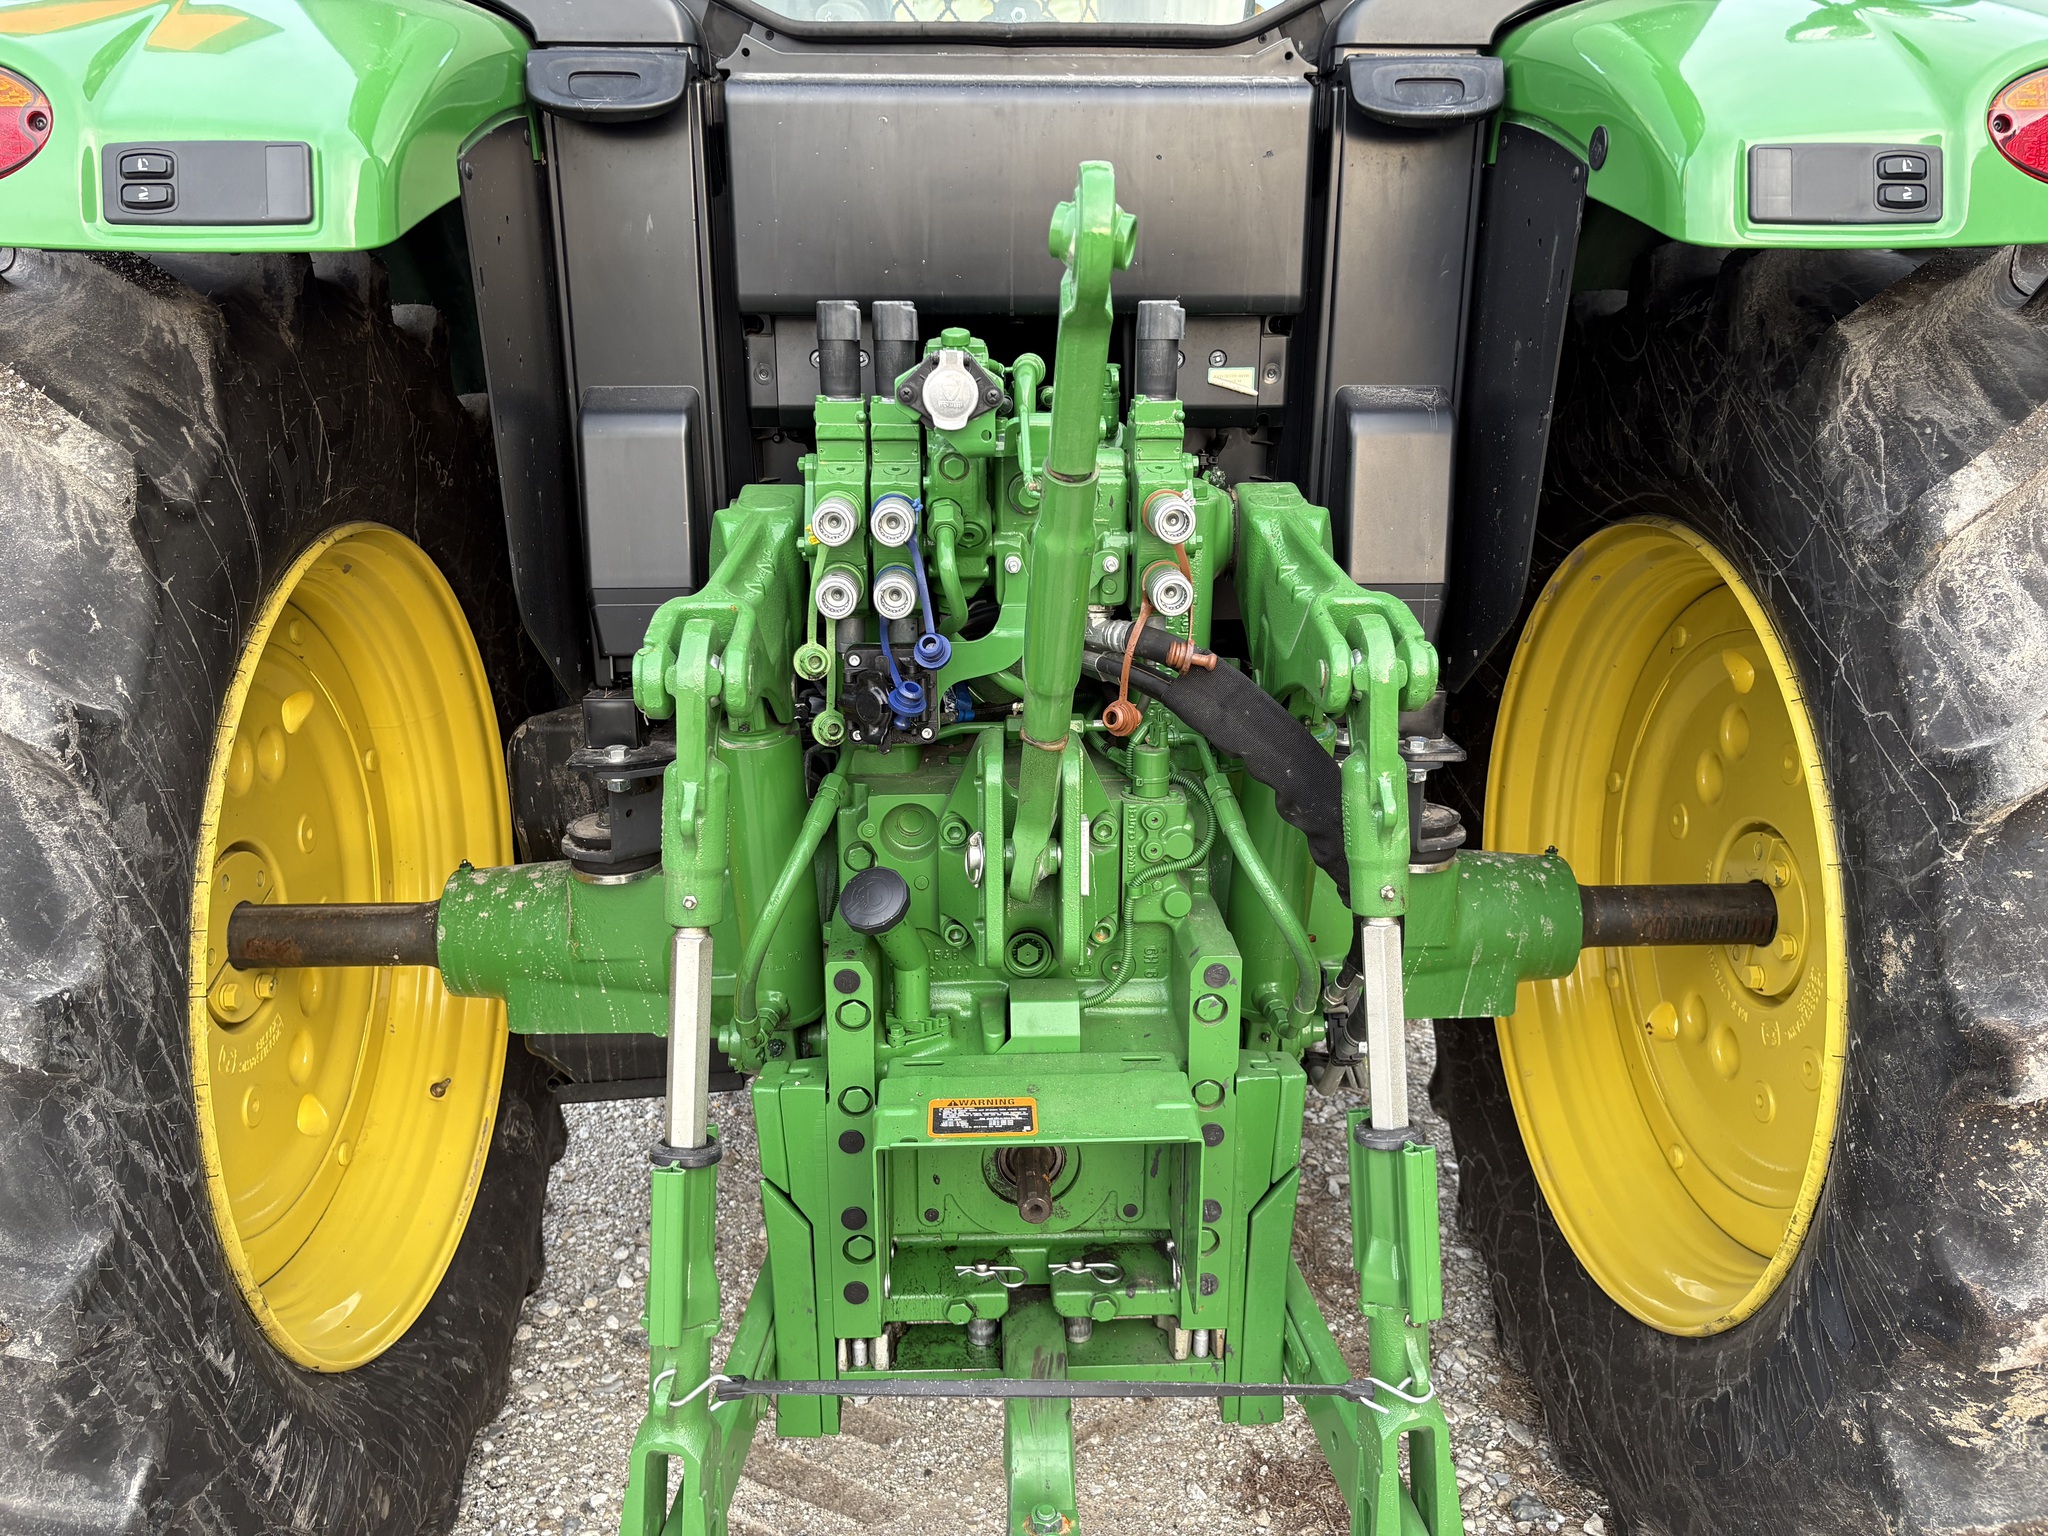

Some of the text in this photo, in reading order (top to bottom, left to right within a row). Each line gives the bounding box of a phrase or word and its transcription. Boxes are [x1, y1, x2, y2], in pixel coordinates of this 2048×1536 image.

[1127, 805, 1137, 874] BRAKE CLUTCH
[958, 1098, 1015, 1106] WARNING
